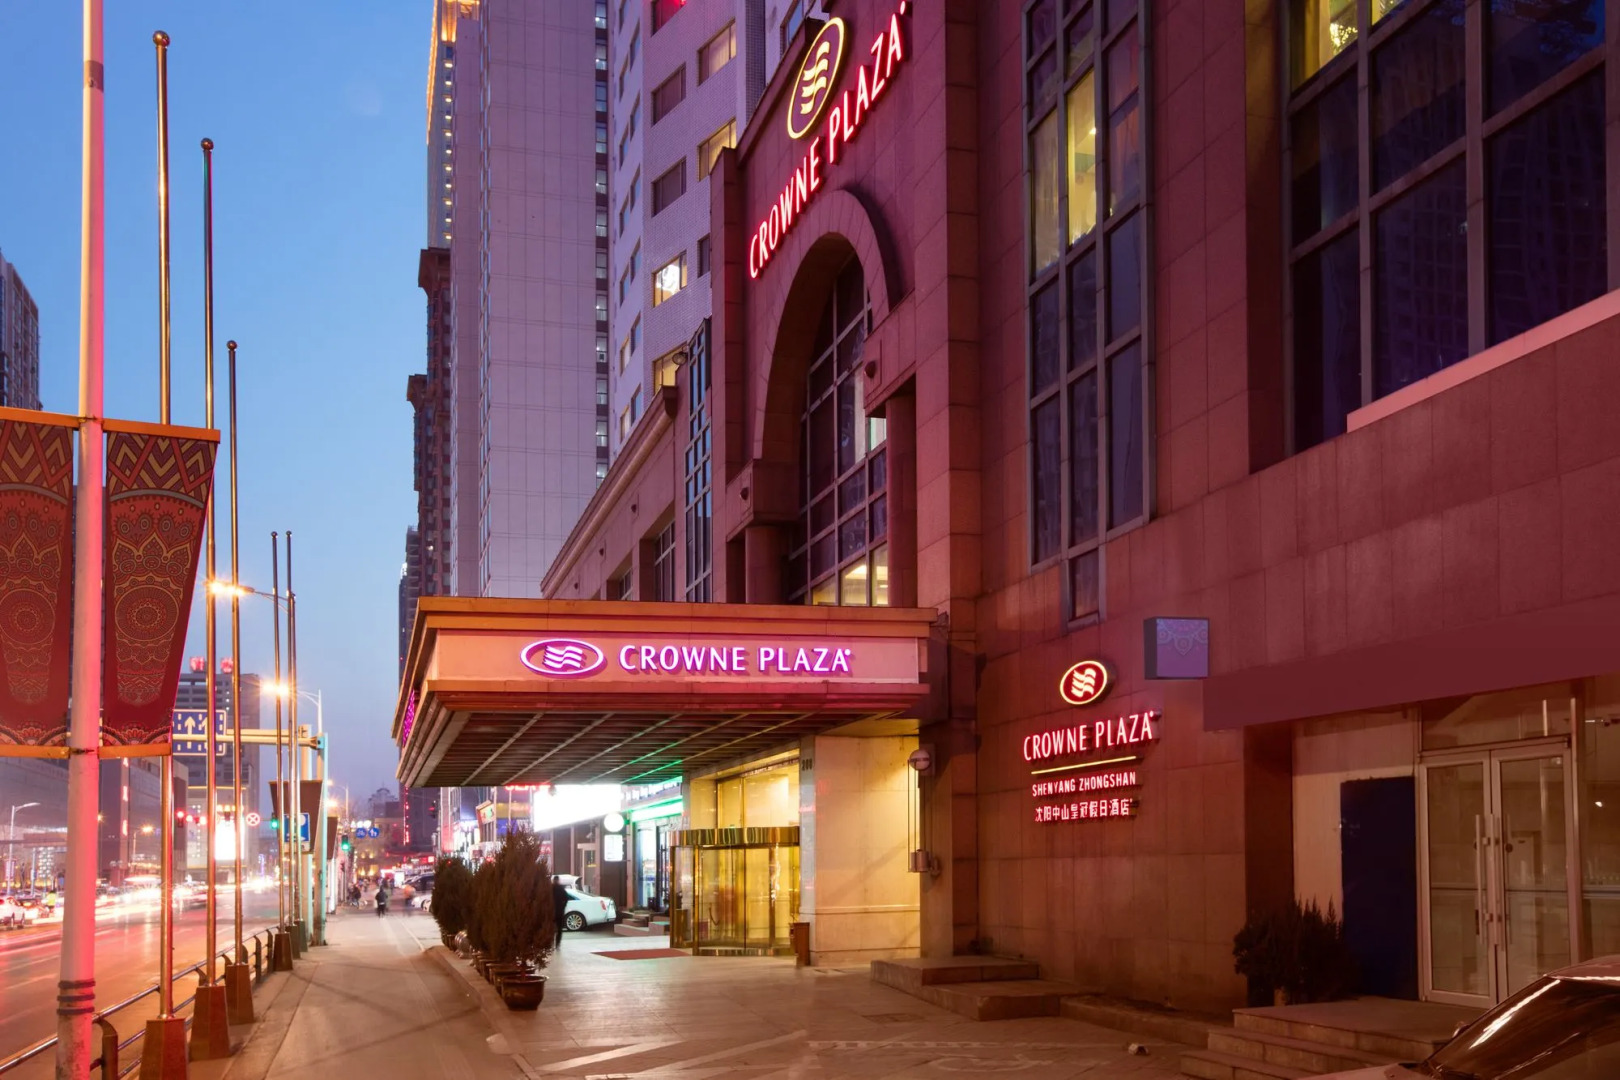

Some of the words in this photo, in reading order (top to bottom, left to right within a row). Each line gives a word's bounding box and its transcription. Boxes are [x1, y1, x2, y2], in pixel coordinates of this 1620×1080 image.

[748, 138, 821, 280] CROWNE
[827, 12, 903, 164] PLAZA
[619, 644, 746, 671] CROWNE
[758, 647, 851, 672] PLAZA
[1023, 724, 1087, 761] CROWNE
[1095, 711, 1154, 748] PLAZA
[1032, 778, 1076, 797] SHENYANG
[1078, 771, 1136, 792] ZHONGSHAN
[1035, 798, 1131, 822] 沈阳中山皇冠假日酒店
